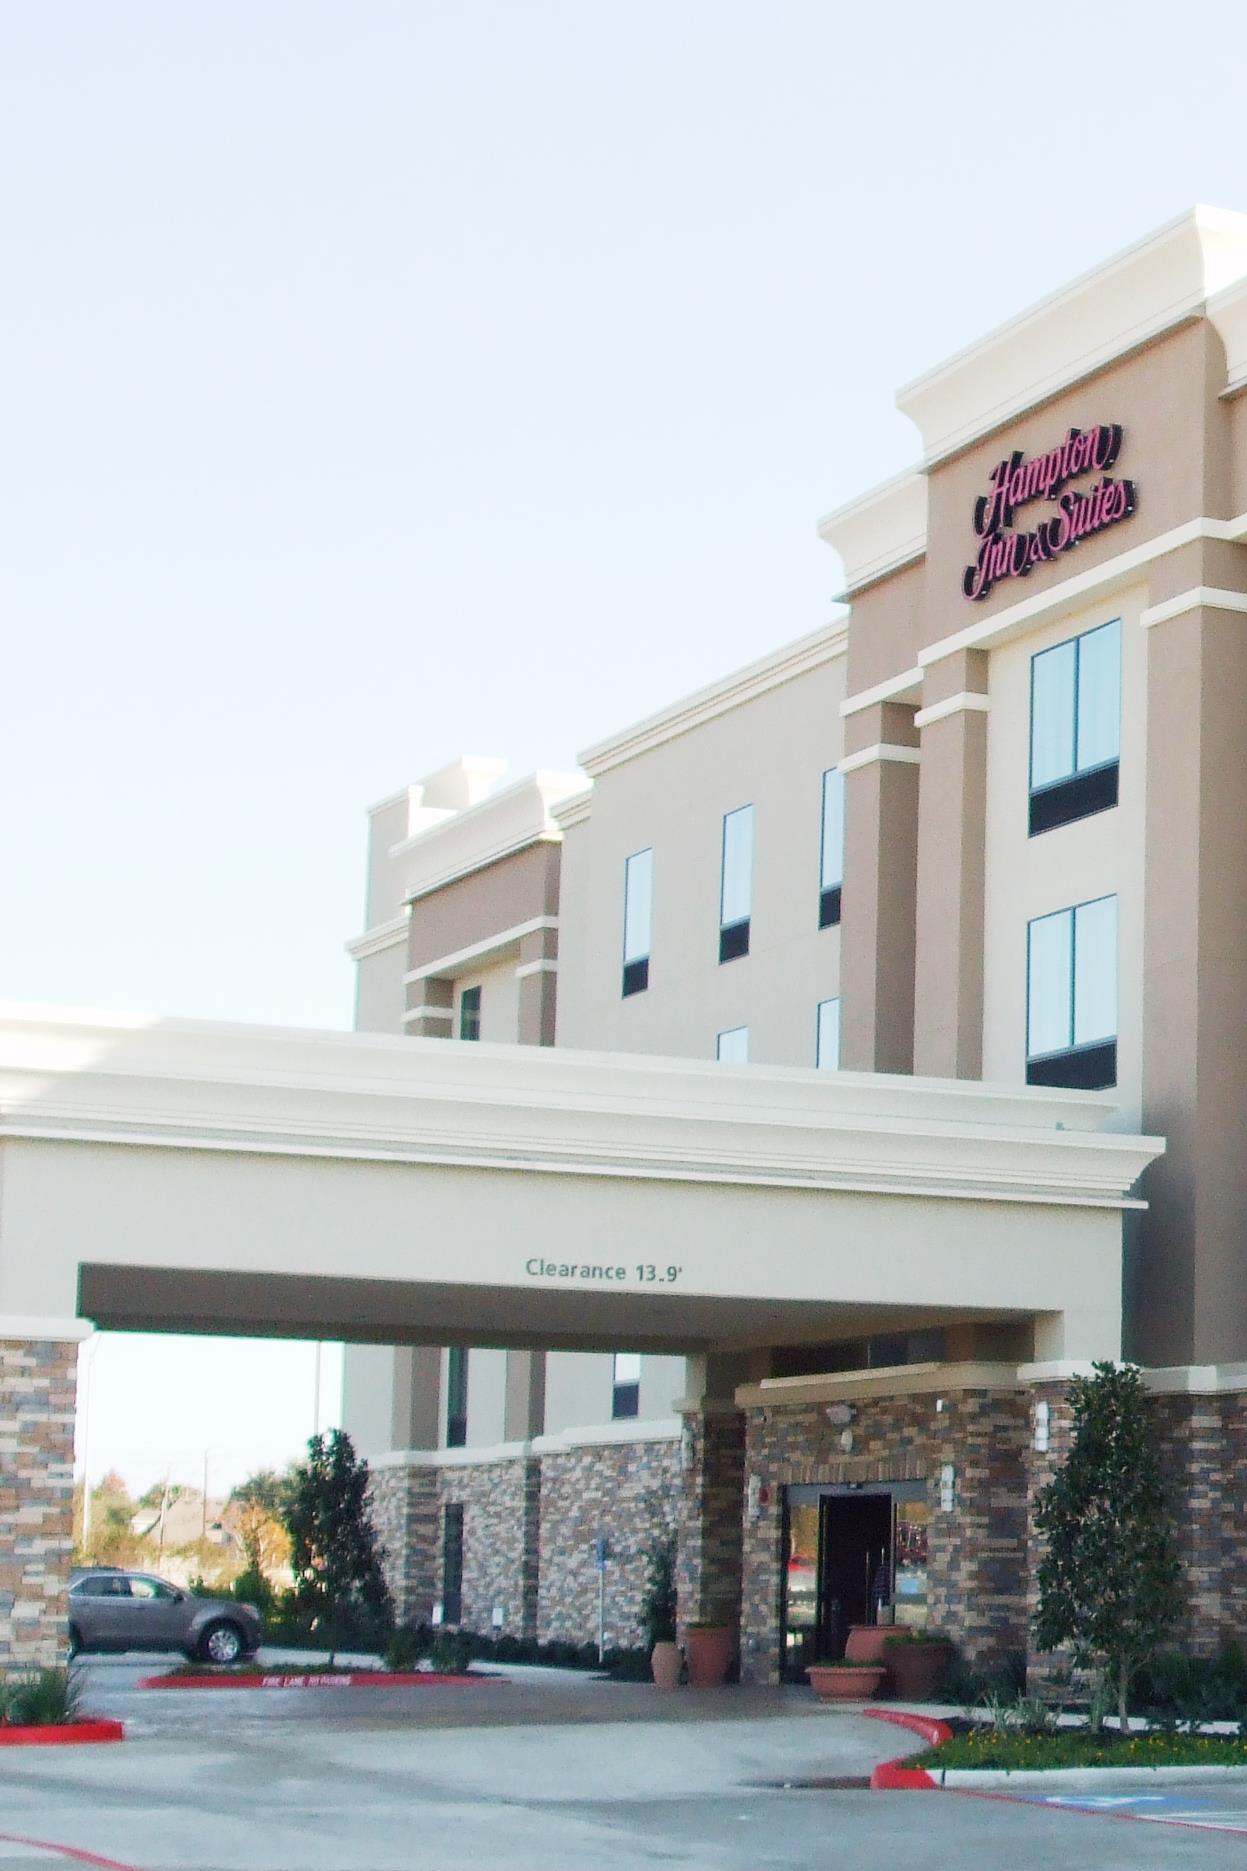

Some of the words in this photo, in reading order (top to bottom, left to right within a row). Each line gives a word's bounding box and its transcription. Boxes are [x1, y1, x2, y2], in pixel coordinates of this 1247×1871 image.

[962, 533, 1033, 600] Inn
[1030, 525, 1054, 561] &
[1047, 476, 1137, 552] Suites
[974, 424, 1121, 539] Hampton
[525, 1257, 627, 1280] Clearance
